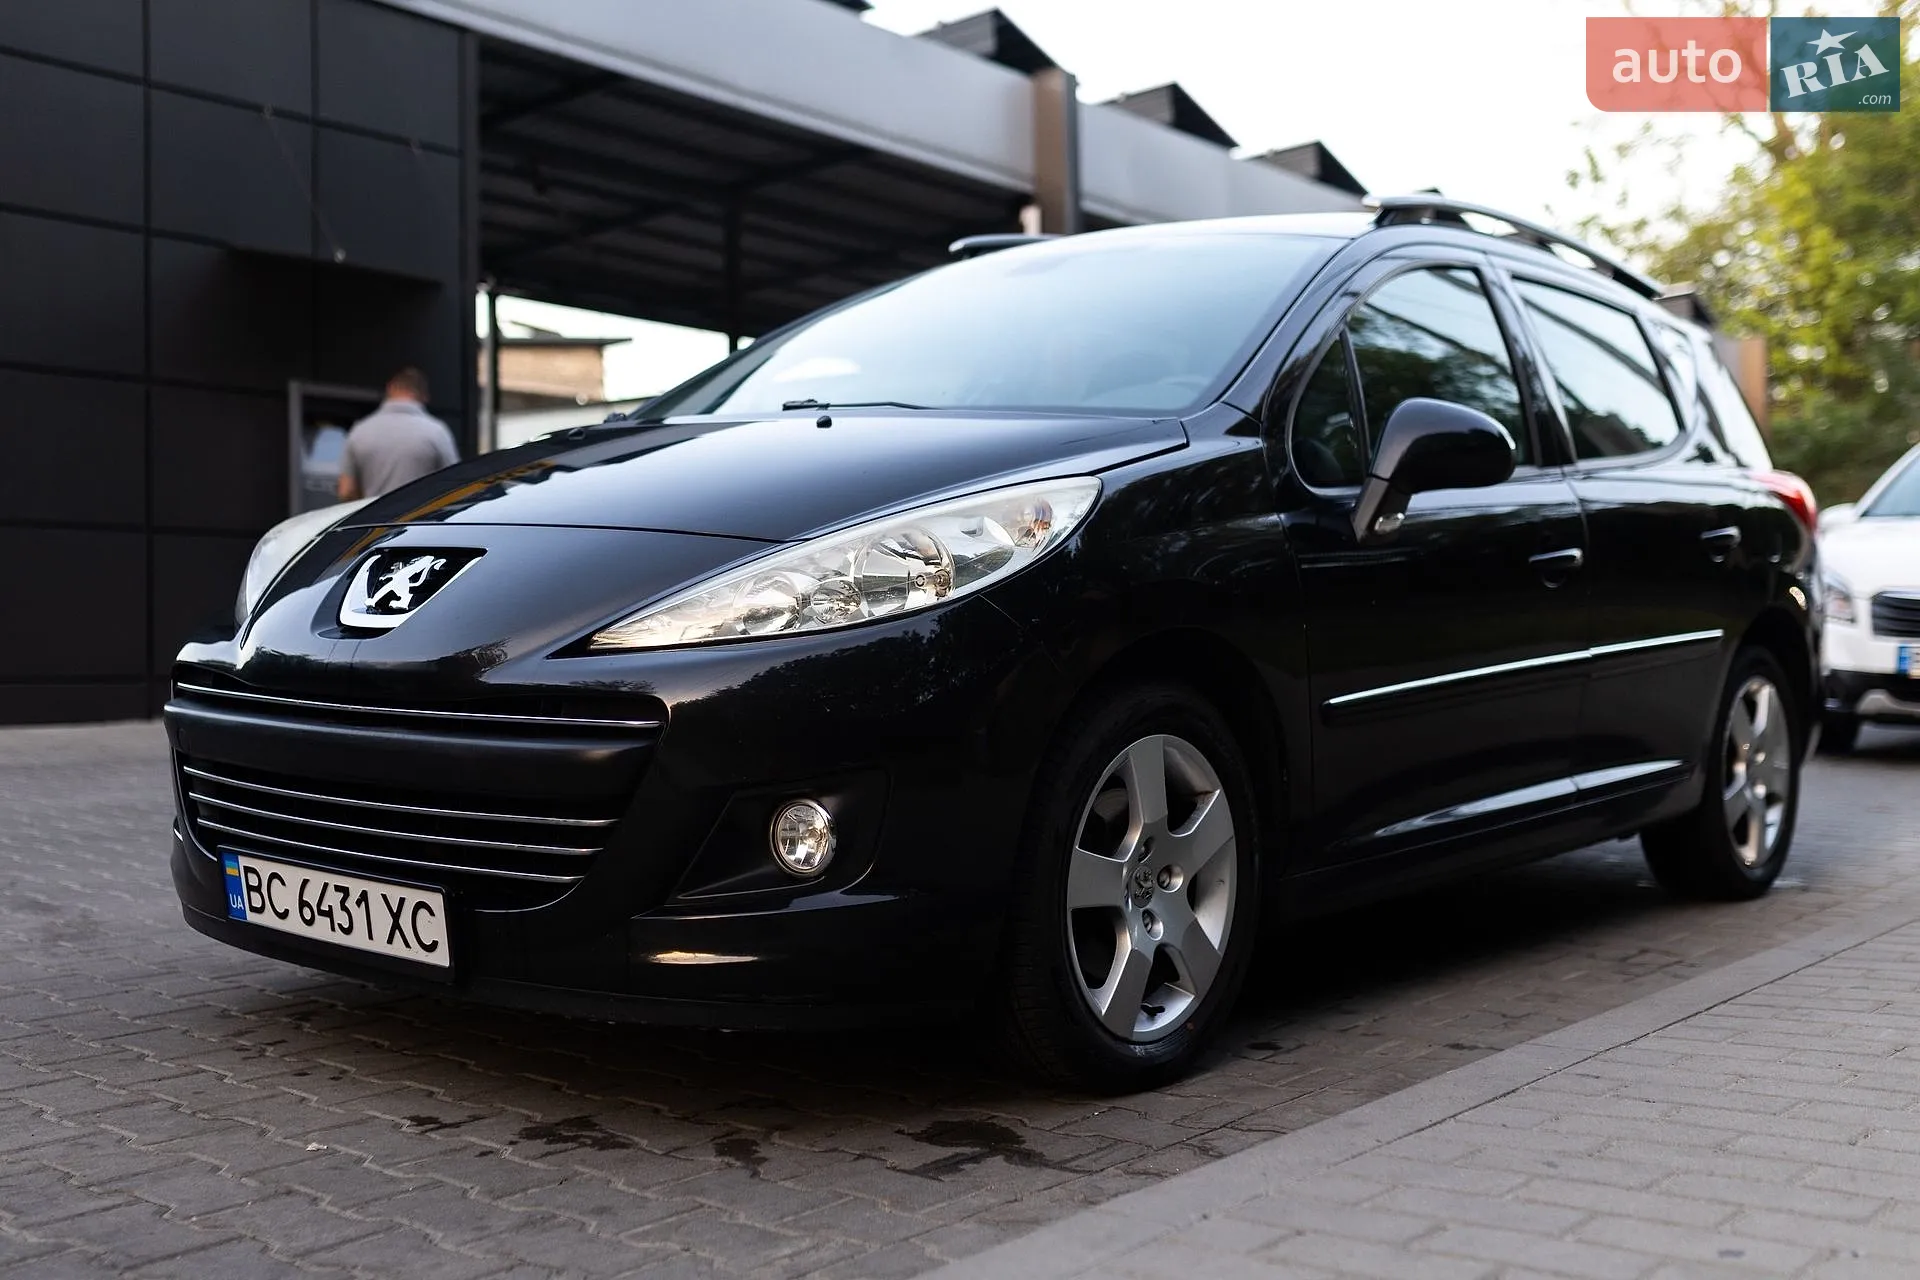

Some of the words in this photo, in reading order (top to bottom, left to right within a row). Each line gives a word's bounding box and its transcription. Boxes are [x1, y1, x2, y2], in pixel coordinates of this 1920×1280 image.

[229, 892, 245, 910] UA
[243, 865, 290, 920] BC
[298, 878, 374, 941] 6431
[380, 892, 439, 953] XC
